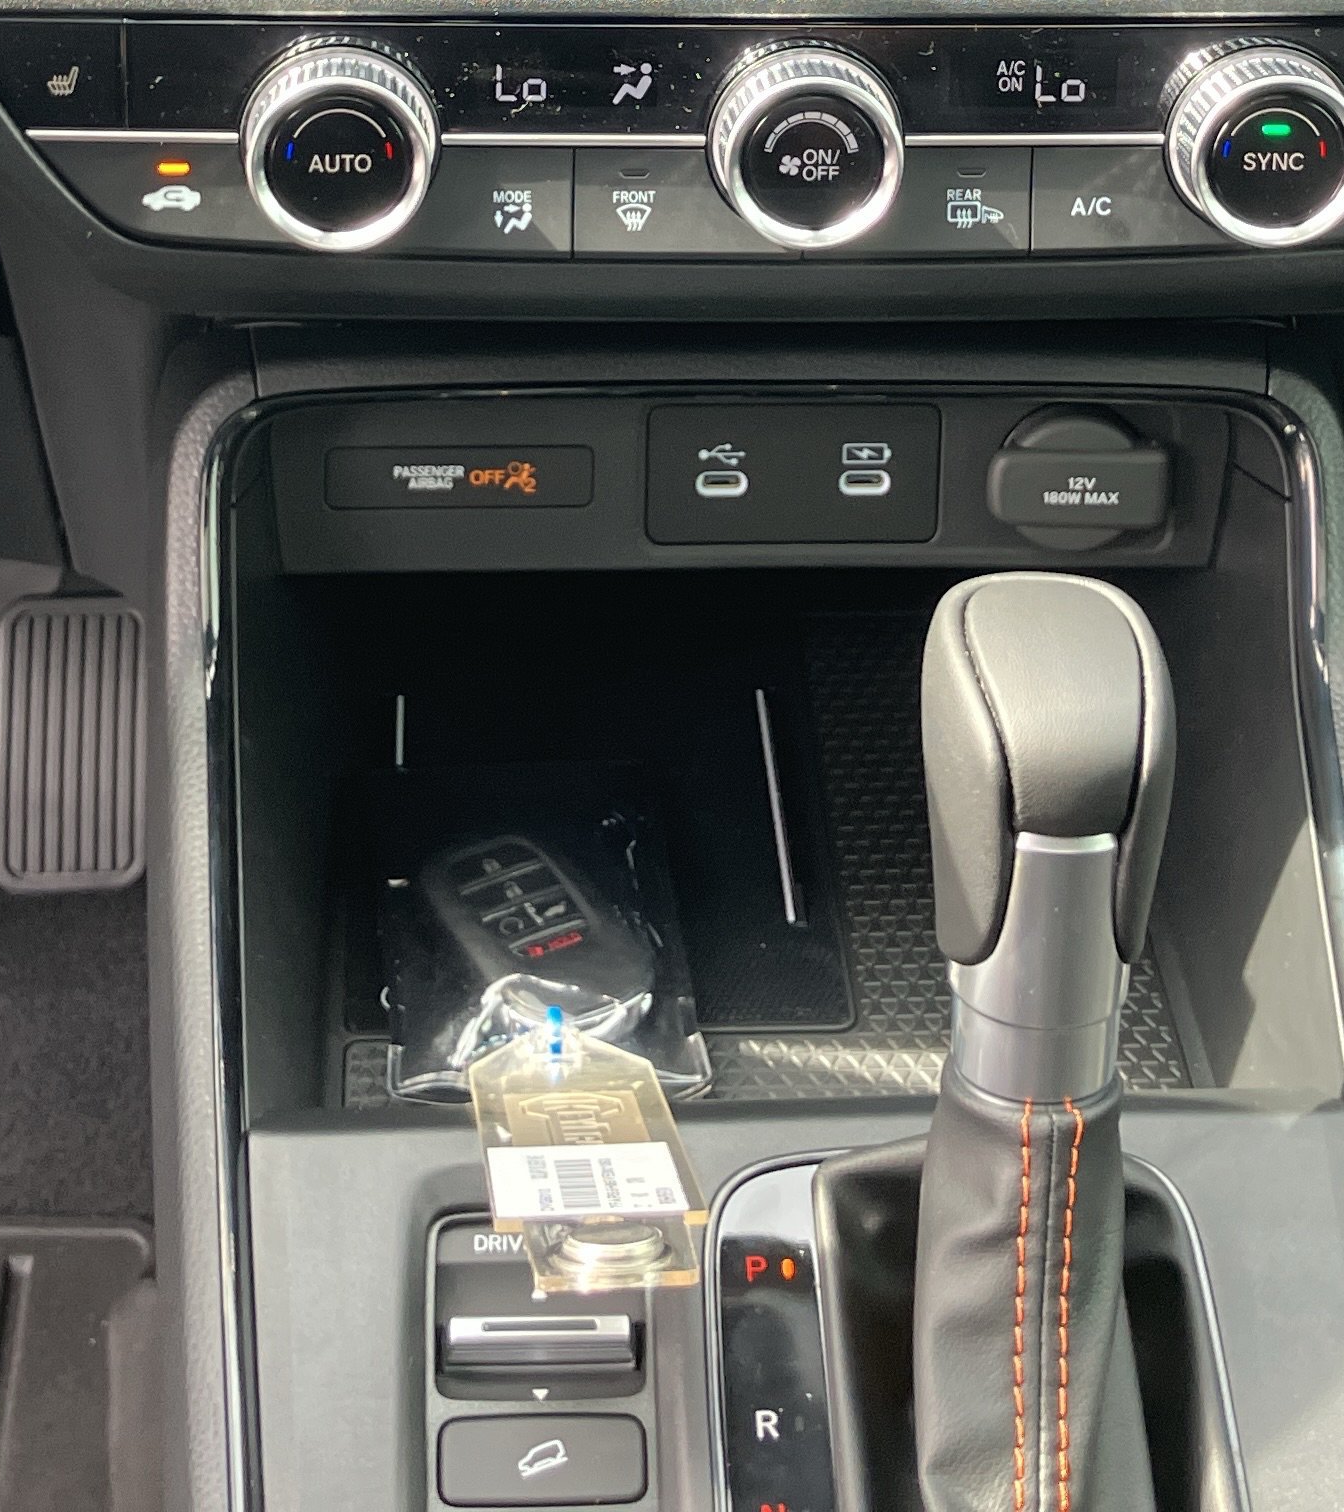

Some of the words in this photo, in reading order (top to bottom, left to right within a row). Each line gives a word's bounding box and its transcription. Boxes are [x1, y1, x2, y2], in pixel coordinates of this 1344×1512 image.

[996, 60, 1026, 76] A/C
[998, 77, 1023, 93] ON
[308, 152, 372, 174] AUTO
[802, 149, 840, 165] ON/
[1242, 152, 1305, 172] SYNC
[802, 166, 840, 182] OFF
[493, 190, 532, 204] MODE
[612, 190, 656, 204] FRONT
[946, 189, 981, 201] REAR
[1070, 196, 1113, 217] A/C
[393, 465, 465, 478] PASSENGER
[468, 469, 505, 485] OFF
[1067, 476, 1097, 491] 12V
[1043, 491, 1082, 505] 180W
[1083, 491, 1120, 505] MAX
[473, 1234, 524, 1252] DRIV
[745, 1255, 768, 1282] P
[755, 1409, 780, 1441] R
